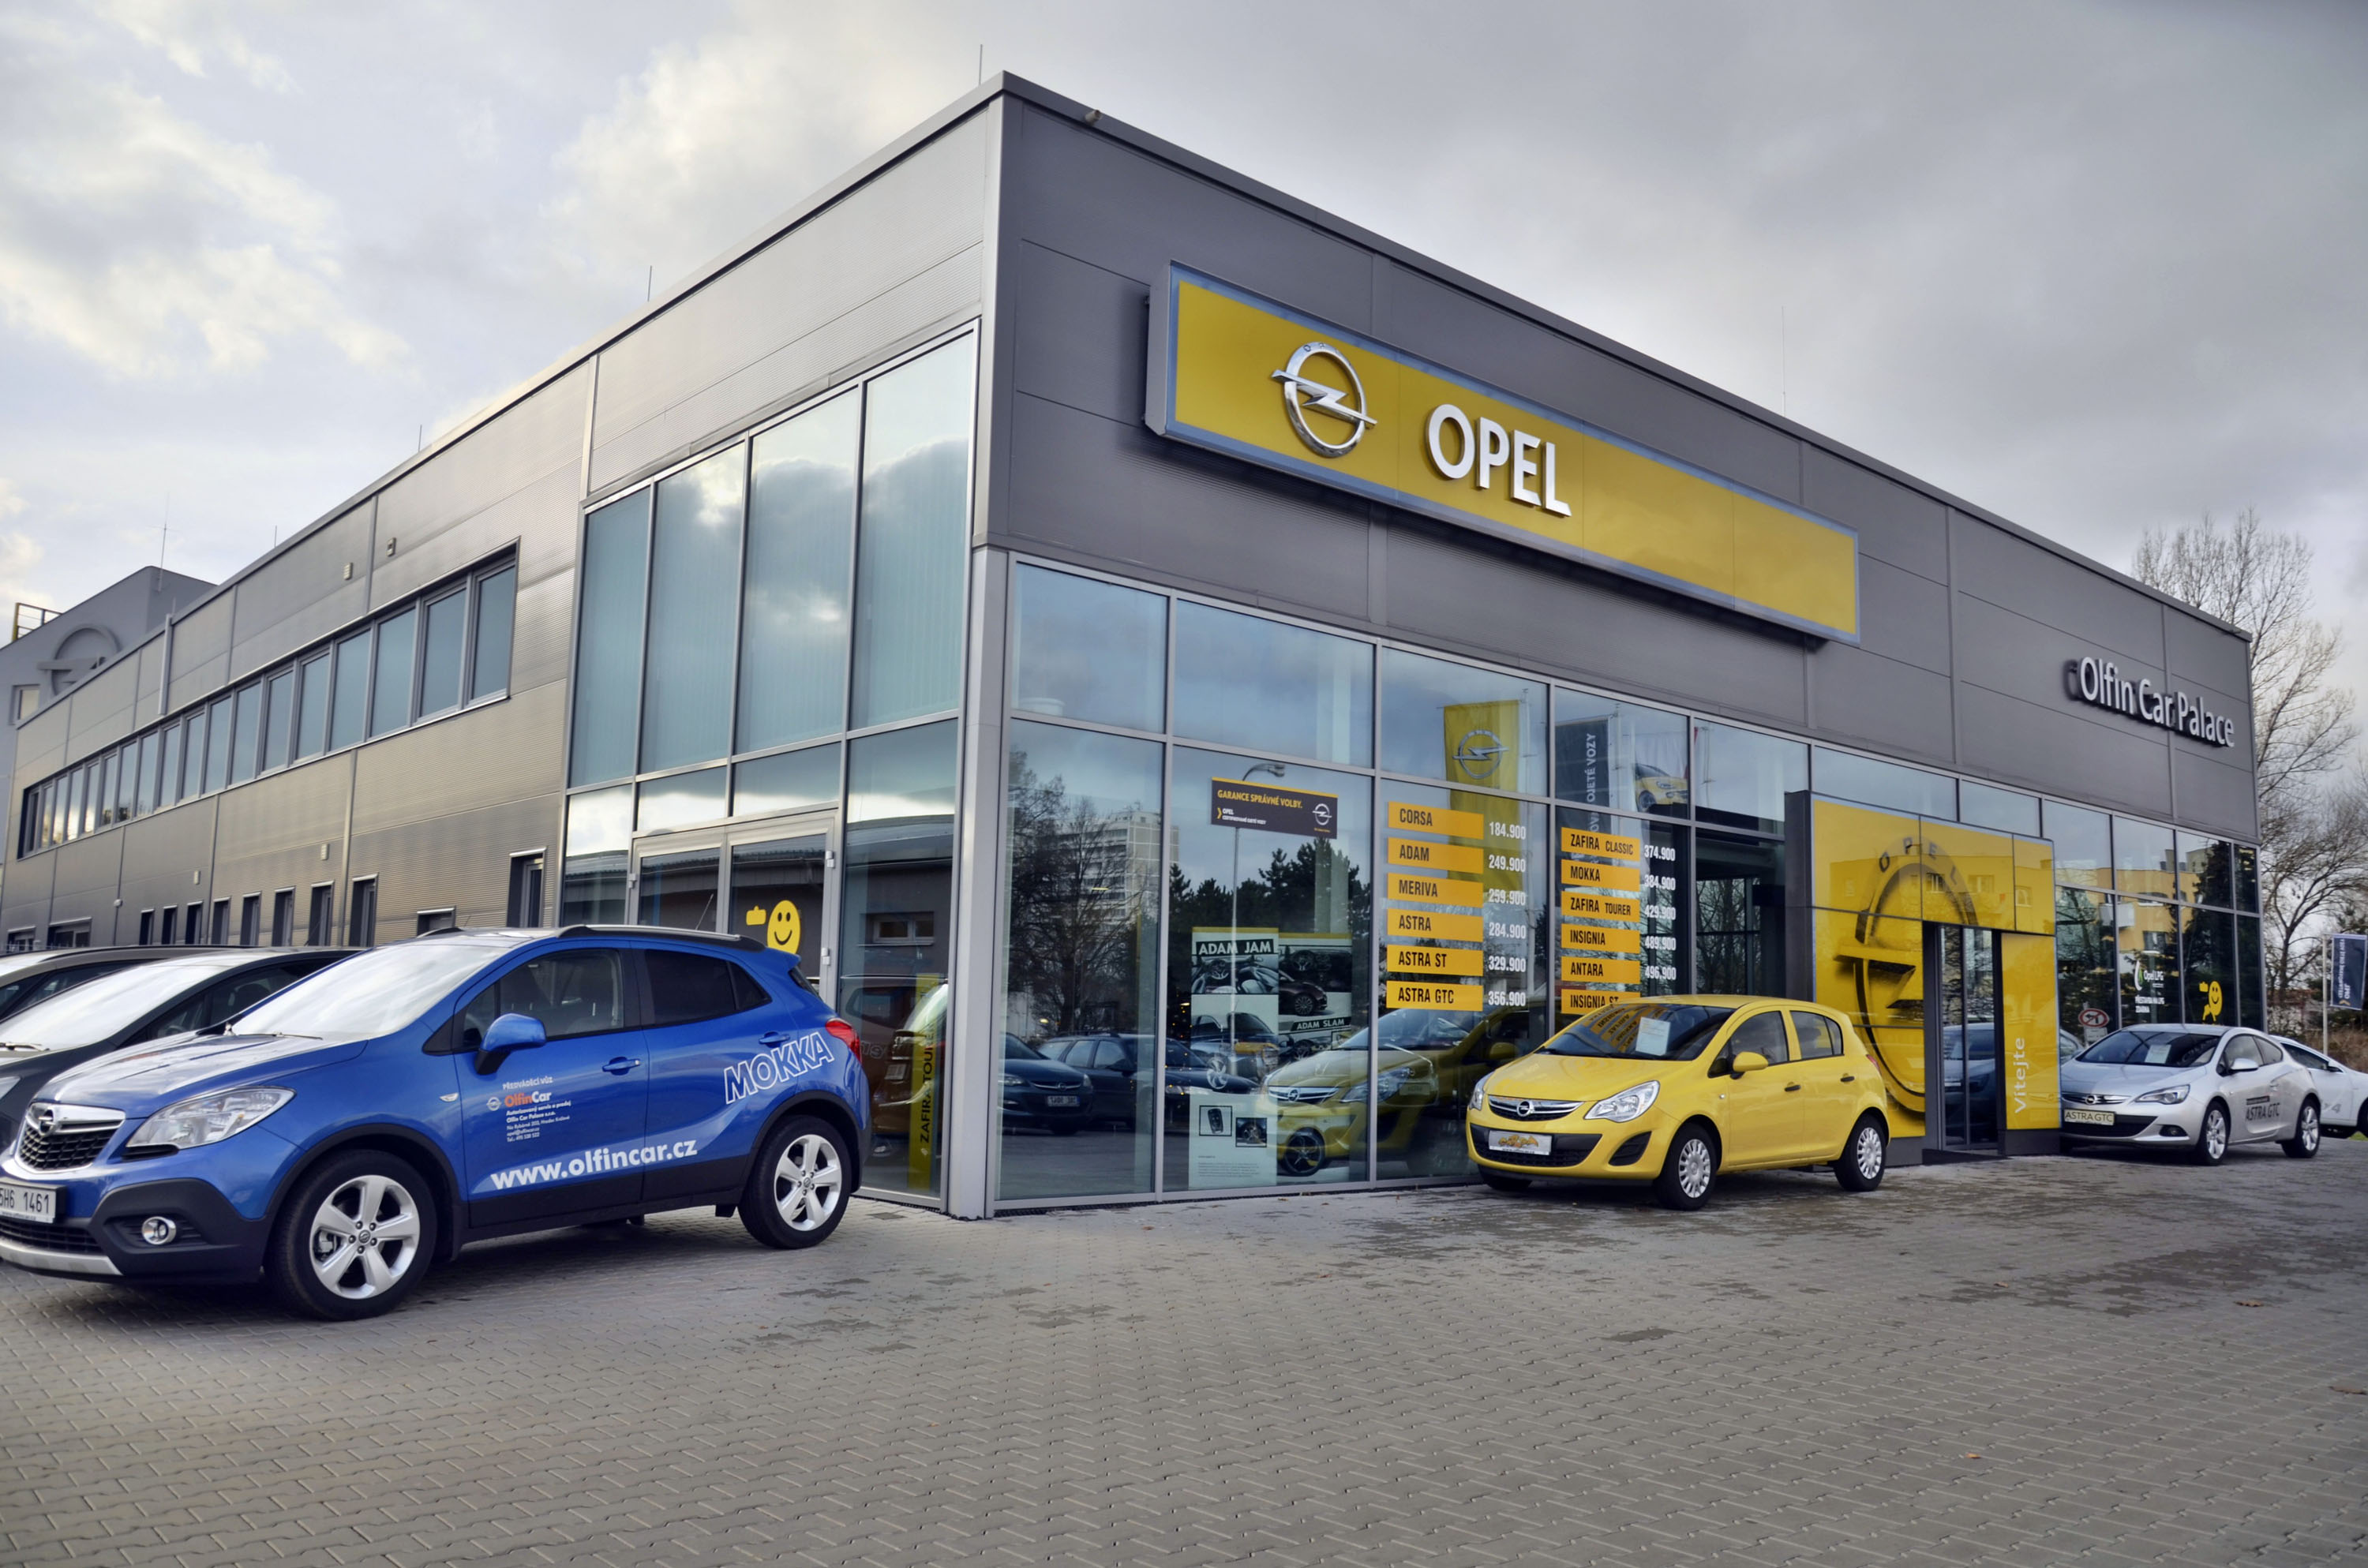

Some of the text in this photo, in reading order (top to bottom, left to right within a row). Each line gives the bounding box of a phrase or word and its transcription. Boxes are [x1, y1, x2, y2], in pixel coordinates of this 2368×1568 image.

[1426, 404, 1572, 518] OPEL
[2080, 657, 2235, 747] Olfin Car Palace
[1587, 733, 1597, 766] VOZY
[1217, 789, 1303, 808] GARANCE SPRÁVNÉ VOLBY.
[1399, 808, 1527, 840] CORSA 184.900
[1399, 844, 1526, 872] ADAM 249.900
[1570, 833, 1676, 861] ZAFIRA CLASSIC 374.900
[1570, 866, 1676, 891] MOKKA 384.900
[1399, 879, 1526, 906] MERIVA 259.900
[1570, 897, 1676, 920] ZAFIRA TOURER 429.900
[1399, 915, 1527, 939] ASTRA 284.900
[1198, 941, 1272, 955] ADAM JAM
[1570, 930, 1677, 951] INSIGNIA 489.900
[1399, 951, 1526, 972] ASTRA ST 329.900
[1571, 962, 1677, 980] ANTARA 496.900
[1398, 987, 1526, 1006] ASTRA GTC 356.900
[1570, 994, 1606, 1008] INSIGNIA
[1296, 1019, 1345, 1031] ADAM SLAM
[724, 1032, 835, 1105] MOKKA
[504, 1091, 552, 1107] OlfinCar
[2065, 1111, 2113, 1122] ASTRA GTC
[2246, 1102, 2280, 1121] ASTRA GTC
[490, 1140, 698, 1190] www.olfincar.cz
[24, 1192, 49, 1214] 1461
